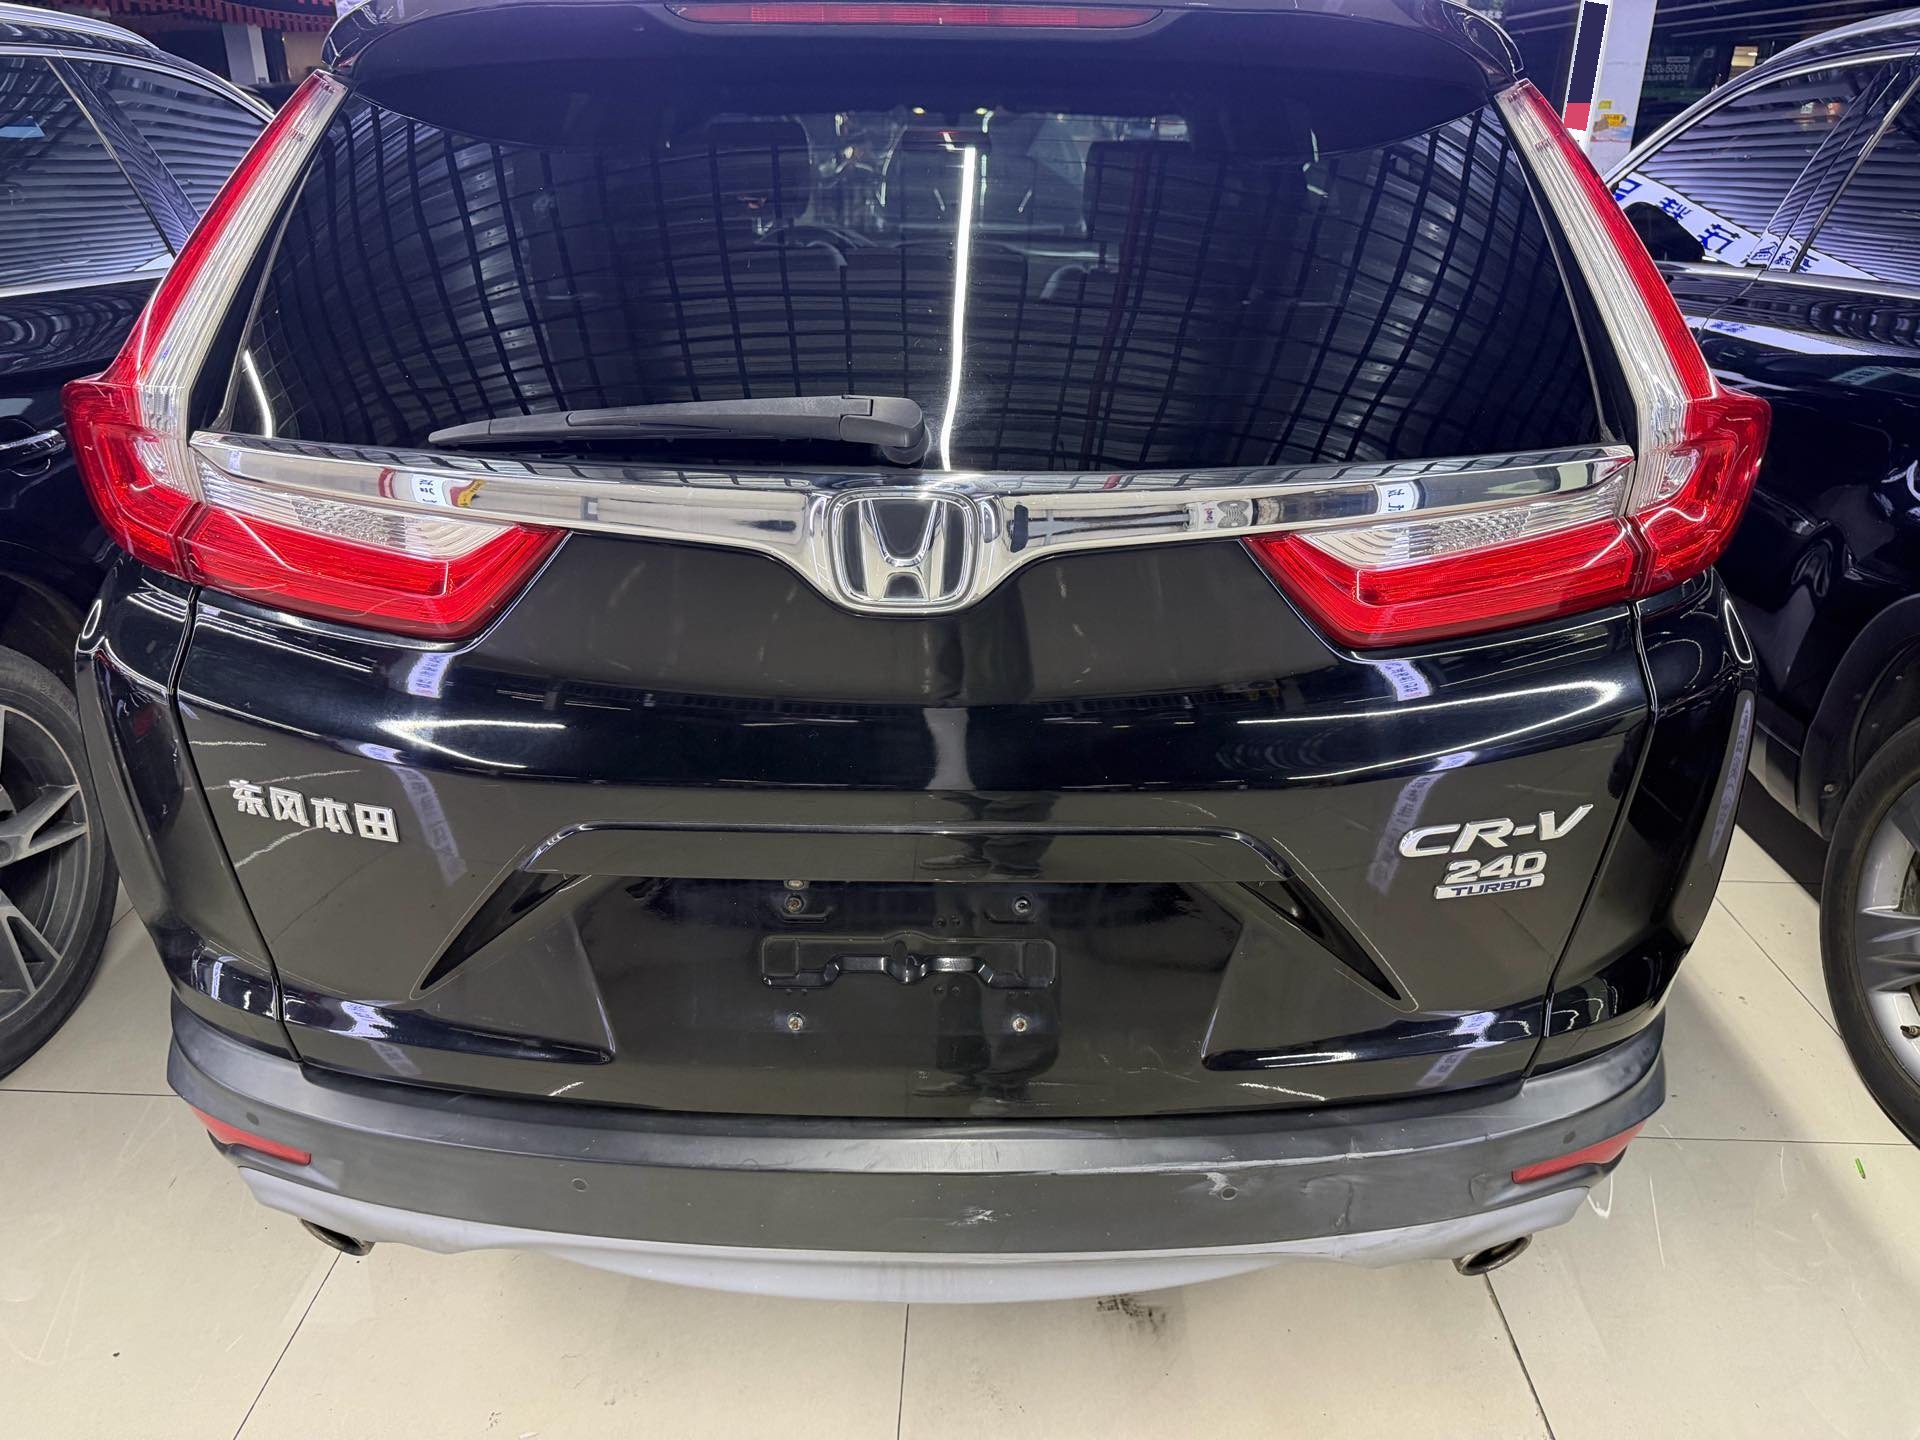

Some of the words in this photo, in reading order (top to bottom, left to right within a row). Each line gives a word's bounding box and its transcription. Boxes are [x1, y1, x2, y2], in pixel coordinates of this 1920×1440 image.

[229, 779, 400, 843] 东风本田
[1399, 803, 1594, 858] CR-V
[1443, 850, 1548, 885] 240
[1450, 878, 1533, 897] TURBO
